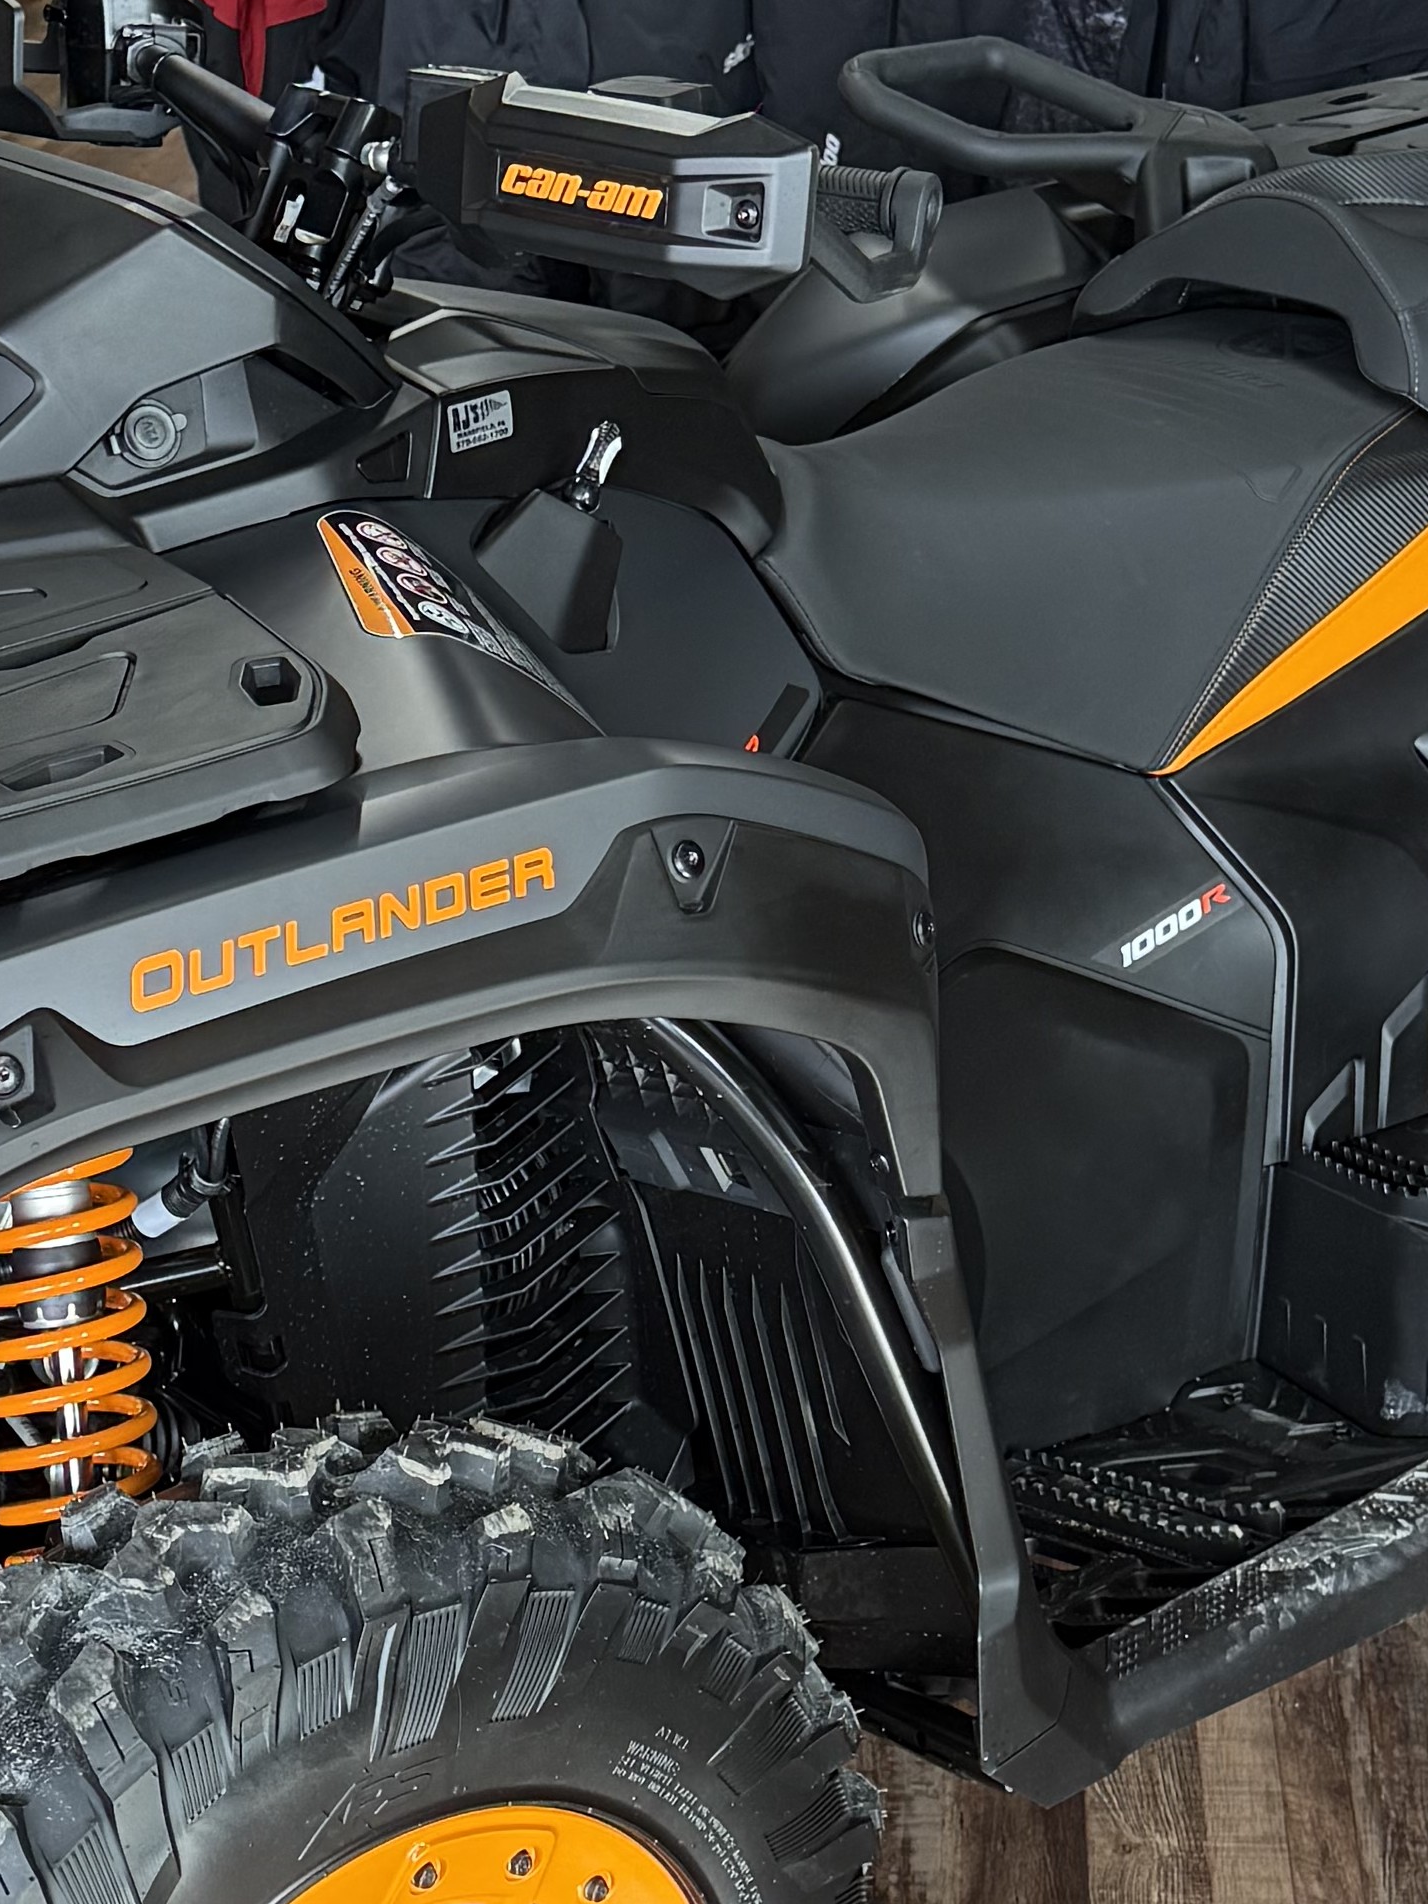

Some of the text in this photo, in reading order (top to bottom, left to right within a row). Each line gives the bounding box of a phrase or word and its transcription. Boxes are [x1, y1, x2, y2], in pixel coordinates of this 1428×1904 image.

[500, 159, 665, 222] can-am
[129, 846, 556, 1014] OUTLANDER
[1121, 882, 1232, 969] 1000R
